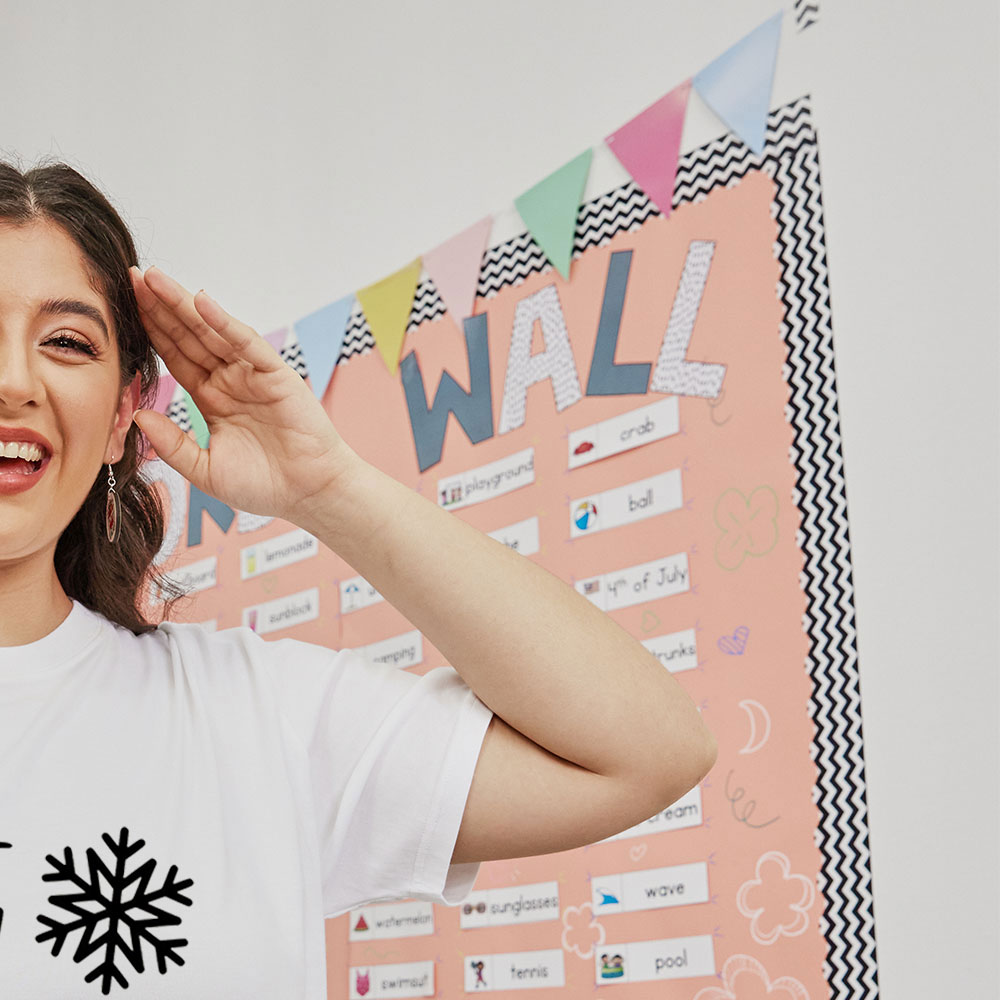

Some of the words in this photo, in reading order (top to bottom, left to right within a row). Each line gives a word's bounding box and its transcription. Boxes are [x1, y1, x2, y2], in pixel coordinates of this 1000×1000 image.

[400, 240, 728, 472] WALL
[620, 416, 655, 441] crab
[465, 453, 534, 495] playground
[628, 488, 654, 512] ball
[265, 536, 314, 562] lemonade
[633, 571, 650, 592] of
[657, 563, 689, 586] July
[648, 803, 700, 823] ream
[645, 881, 686, 899] wave
[490, 893, 559, 916] sunglasses
[375, 911, 433, 929] watermelon
[511, 965, 550, 981] tennis
[655, 948, 689, 974] pool
[381, 972, 429, 991] swimsuit
